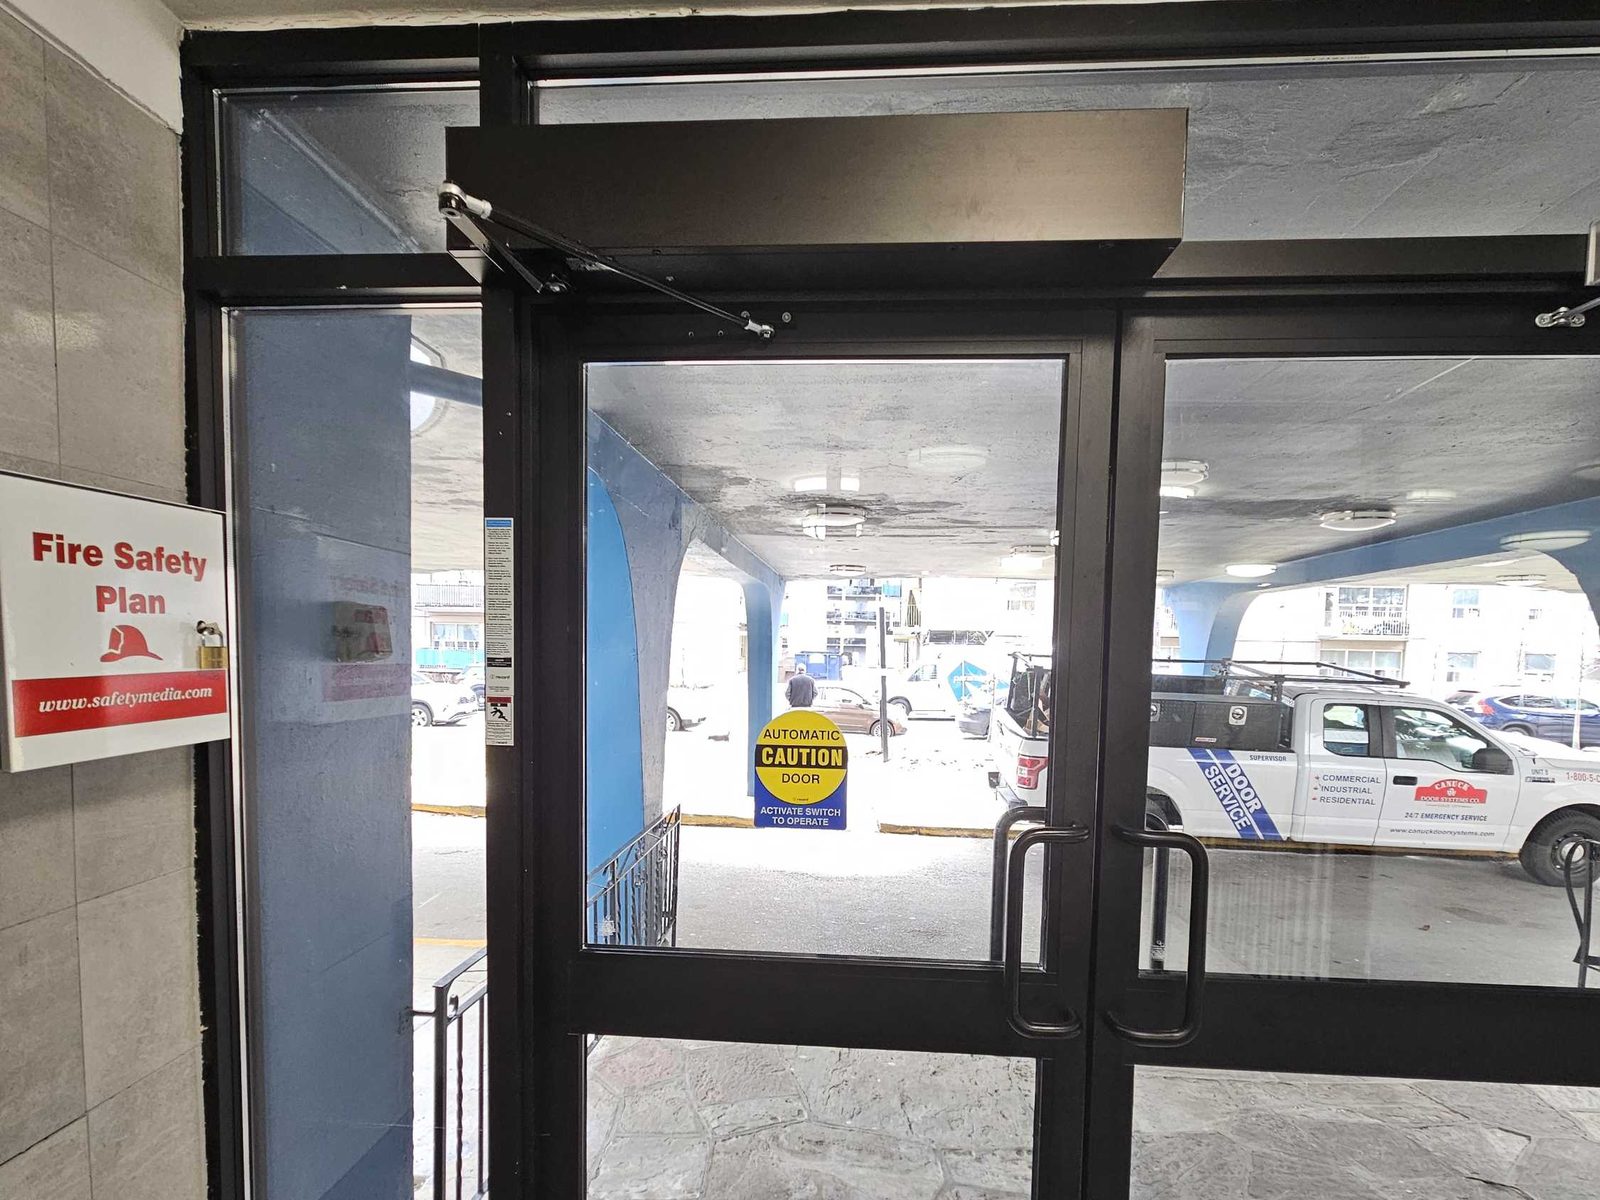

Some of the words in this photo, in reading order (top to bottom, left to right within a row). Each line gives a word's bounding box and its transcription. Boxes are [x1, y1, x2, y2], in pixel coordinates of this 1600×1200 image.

[32, 532, 103, 567] Fire
[114, 542, 208, 582] Safety
[95, 585, 166, 614] Plan
[39, 686, 213, 713] www.safetymedia.com
[763, 729, 840, 741] AUTOMATIC
[761, 747, 843, 766] CAUTION
[1249, 754, 1287, 762] SUPERVISOR
[782, 773, 820, 784] DOOR
[1322, 774, 1381, 784] COMMERCIAL
[1225, 763, 1262, 813] DOOR
[1321, 785, 1373, 795] INDUSTRIAL
[1434, 780, 1471, 791] CANUCK
[1204, 765, 1251, 830] SERVICE
[1319, 796, 1376, 806] RESIDENTIAL
[760, 806, 803, 816] ACTIVATE
[805, 807, 841, 817] SWITCH
[1420, 812, 1459, 820] EMERGENCY
[1460, 814, 1488, 822] SERVICE
[772, 816, 785, 825] TO
[787, 817, 829, 826] OPERATE
